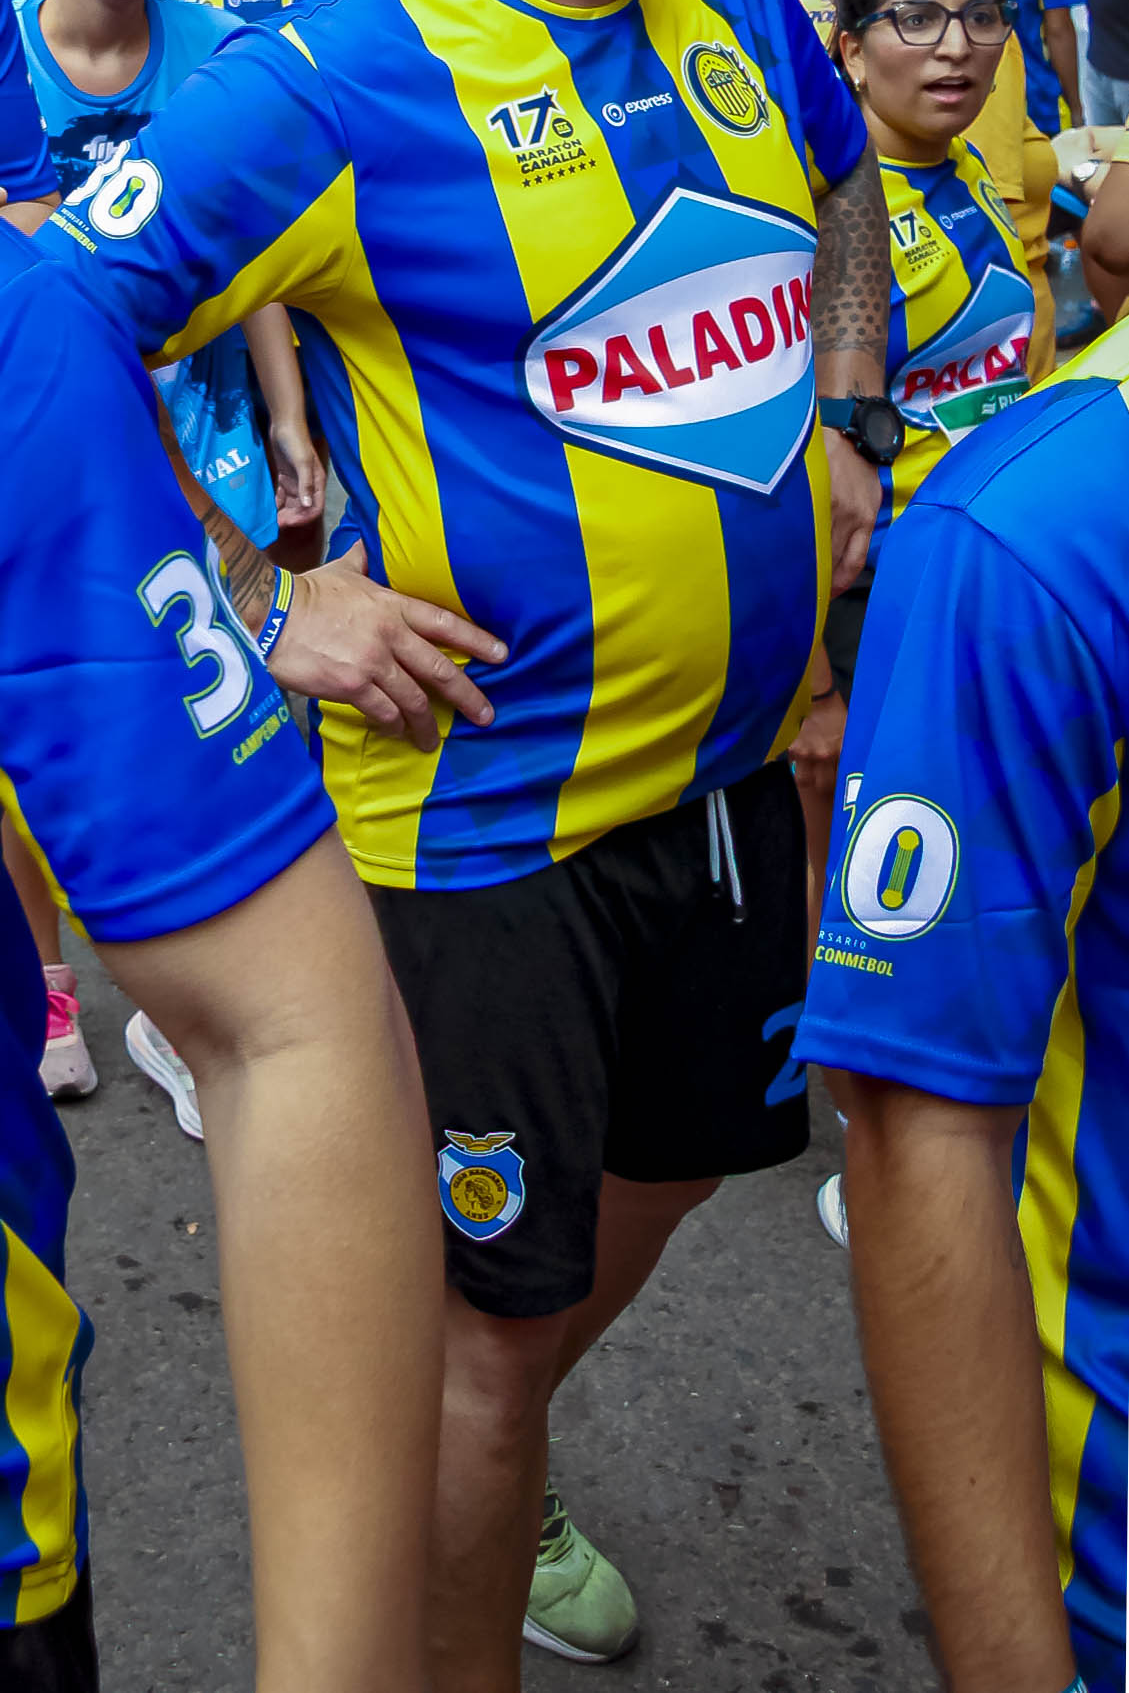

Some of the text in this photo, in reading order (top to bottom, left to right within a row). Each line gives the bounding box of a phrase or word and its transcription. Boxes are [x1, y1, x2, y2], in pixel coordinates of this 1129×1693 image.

[625, 92, 672, 113] express
[489, 90, 560, 149] 17
[516, 138, 582, 164] MARATÓN
[521, 147, 587, 174] CANALLA
[543, 269, 812, 413] PALADIN
[815, 945, 894, 977] CONMEBOL
